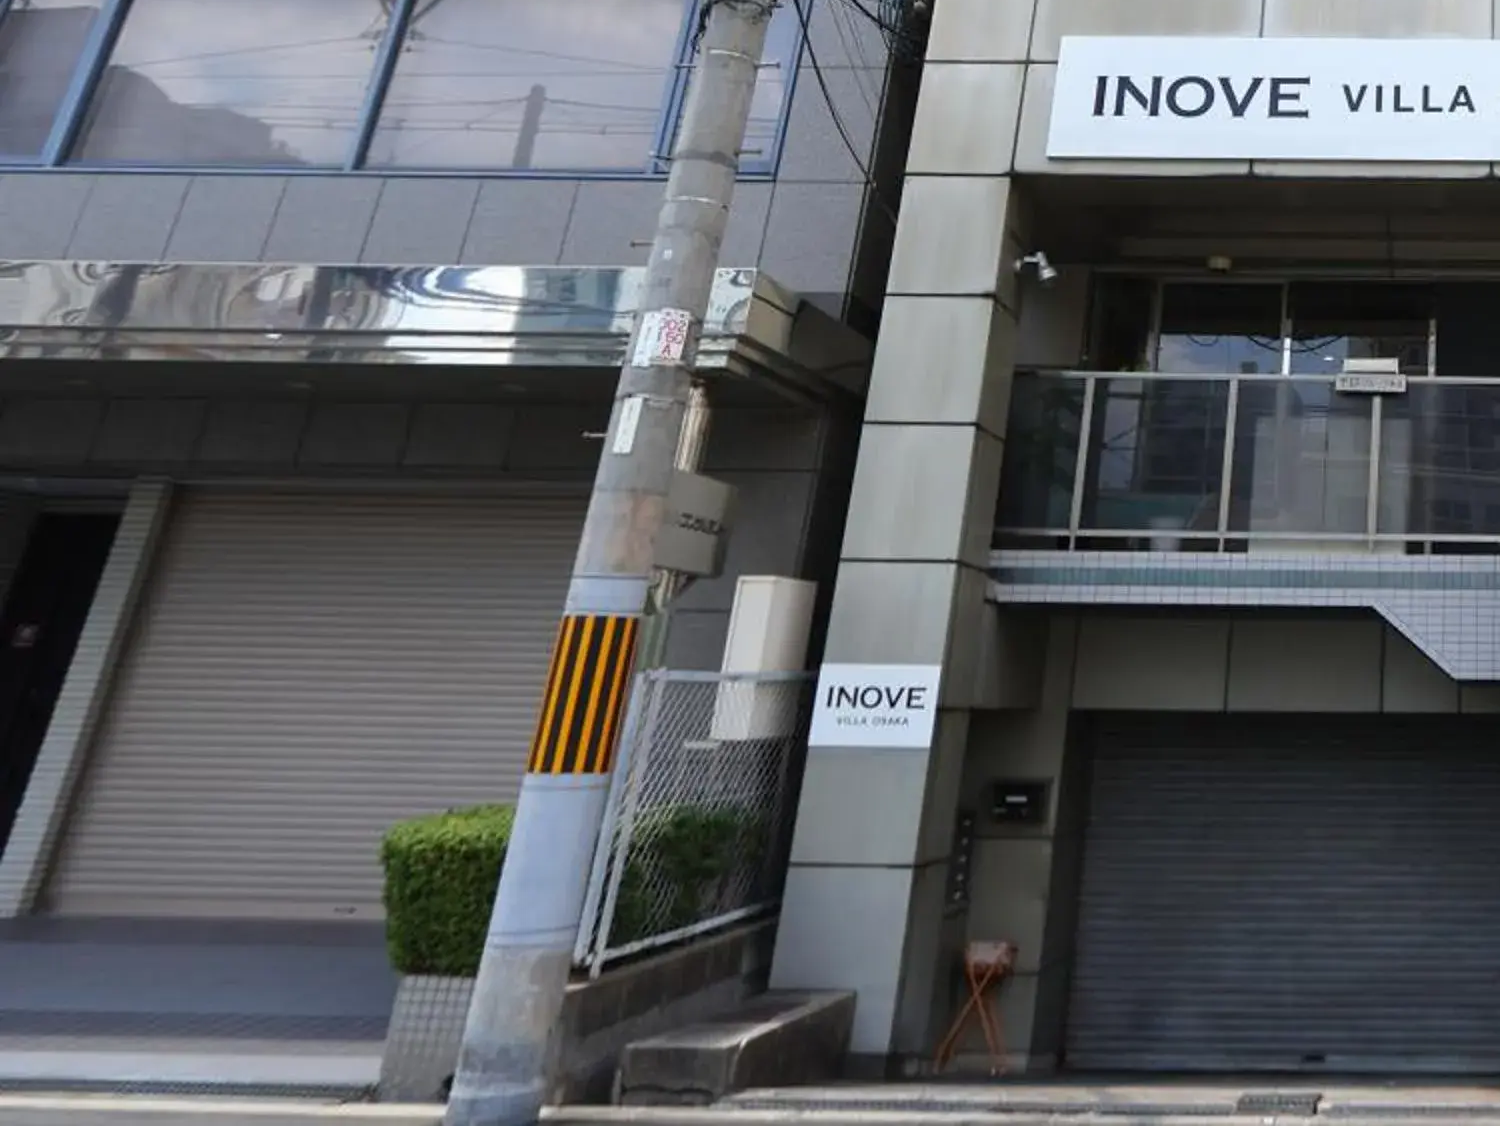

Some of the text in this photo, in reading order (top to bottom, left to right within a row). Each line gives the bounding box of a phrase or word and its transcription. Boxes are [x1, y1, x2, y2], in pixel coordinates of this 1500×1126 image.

[1093, 75, 1311, 118] INOVE
[1342, 84, 1476, 113] VILLA
[826, 685, 927, 710] INOVE
